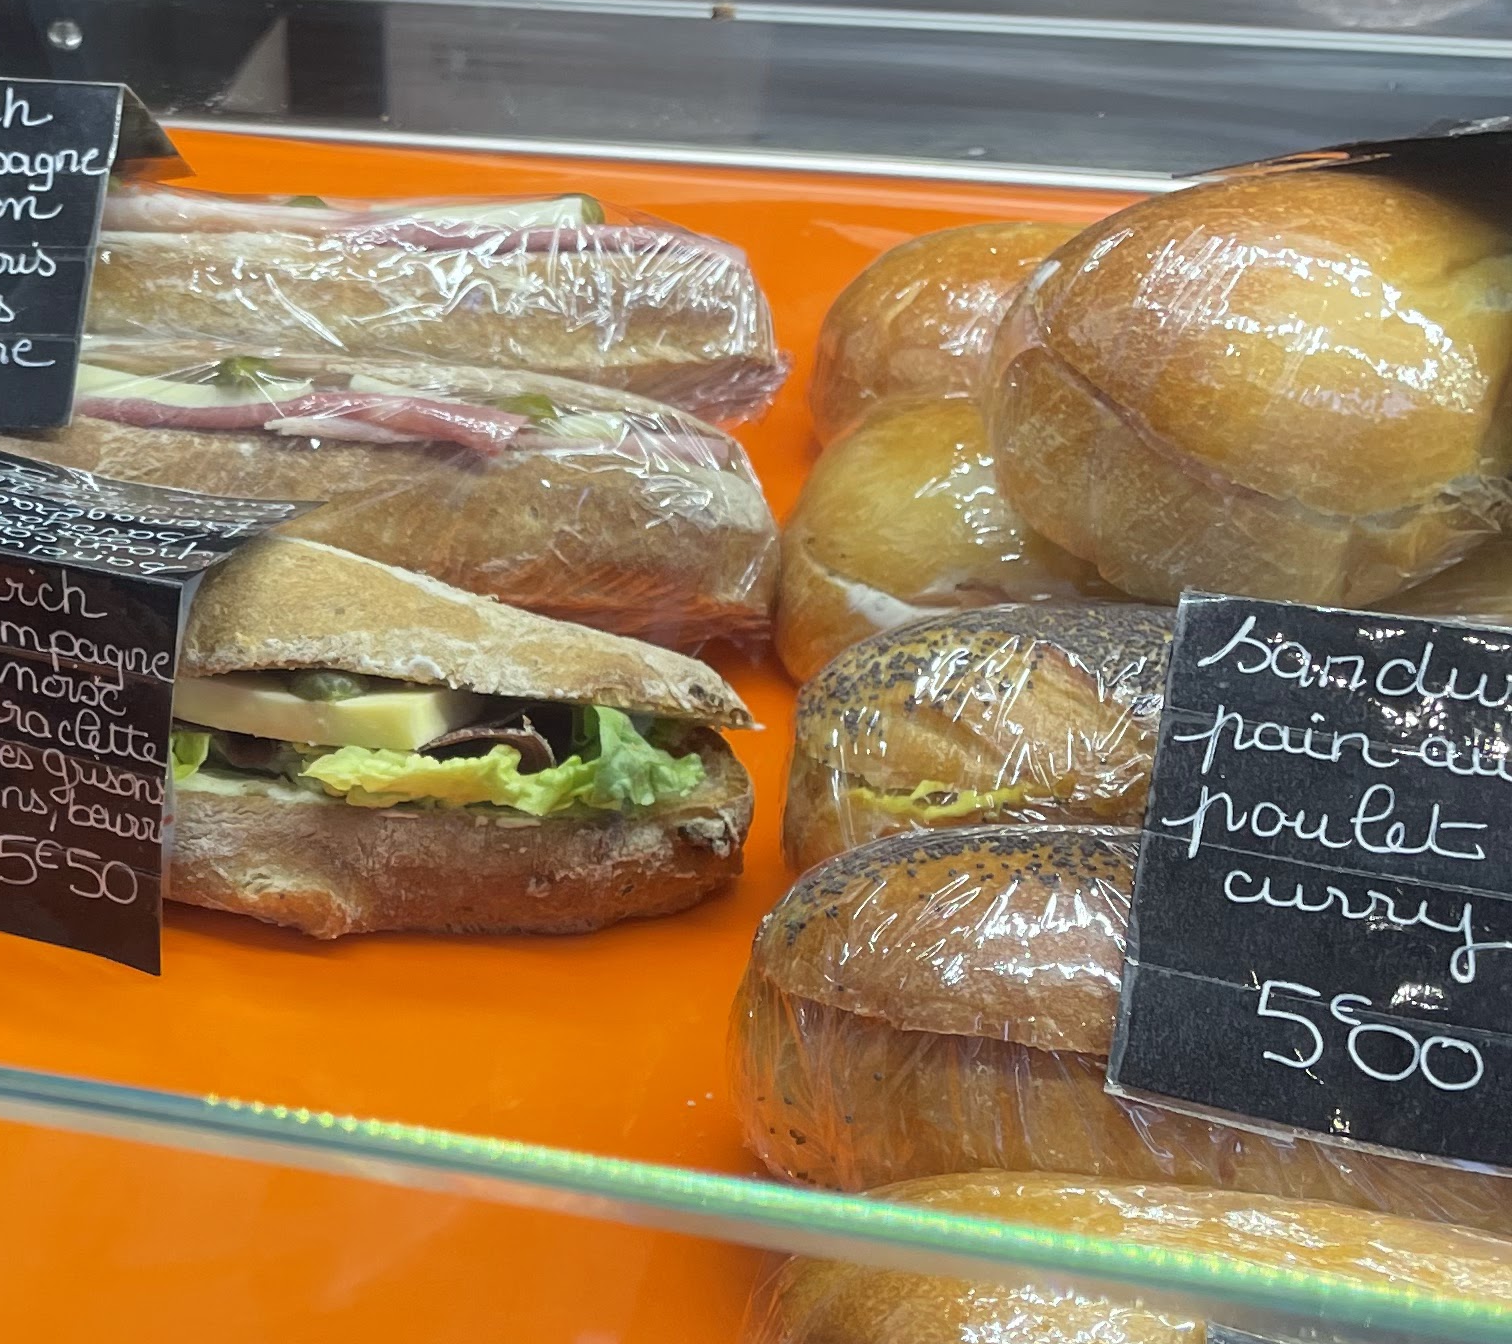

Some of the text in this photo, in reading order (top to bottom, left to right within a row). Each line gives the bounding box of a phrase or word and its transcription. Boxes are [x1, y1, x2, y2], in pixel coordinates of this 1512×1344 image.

[1173, 704, 1400, 774] pain
[68, 787, 163, 844] beurr
[1162, 782, 1488, 859] poulet
[1224, 868, 1512, 984] curry
